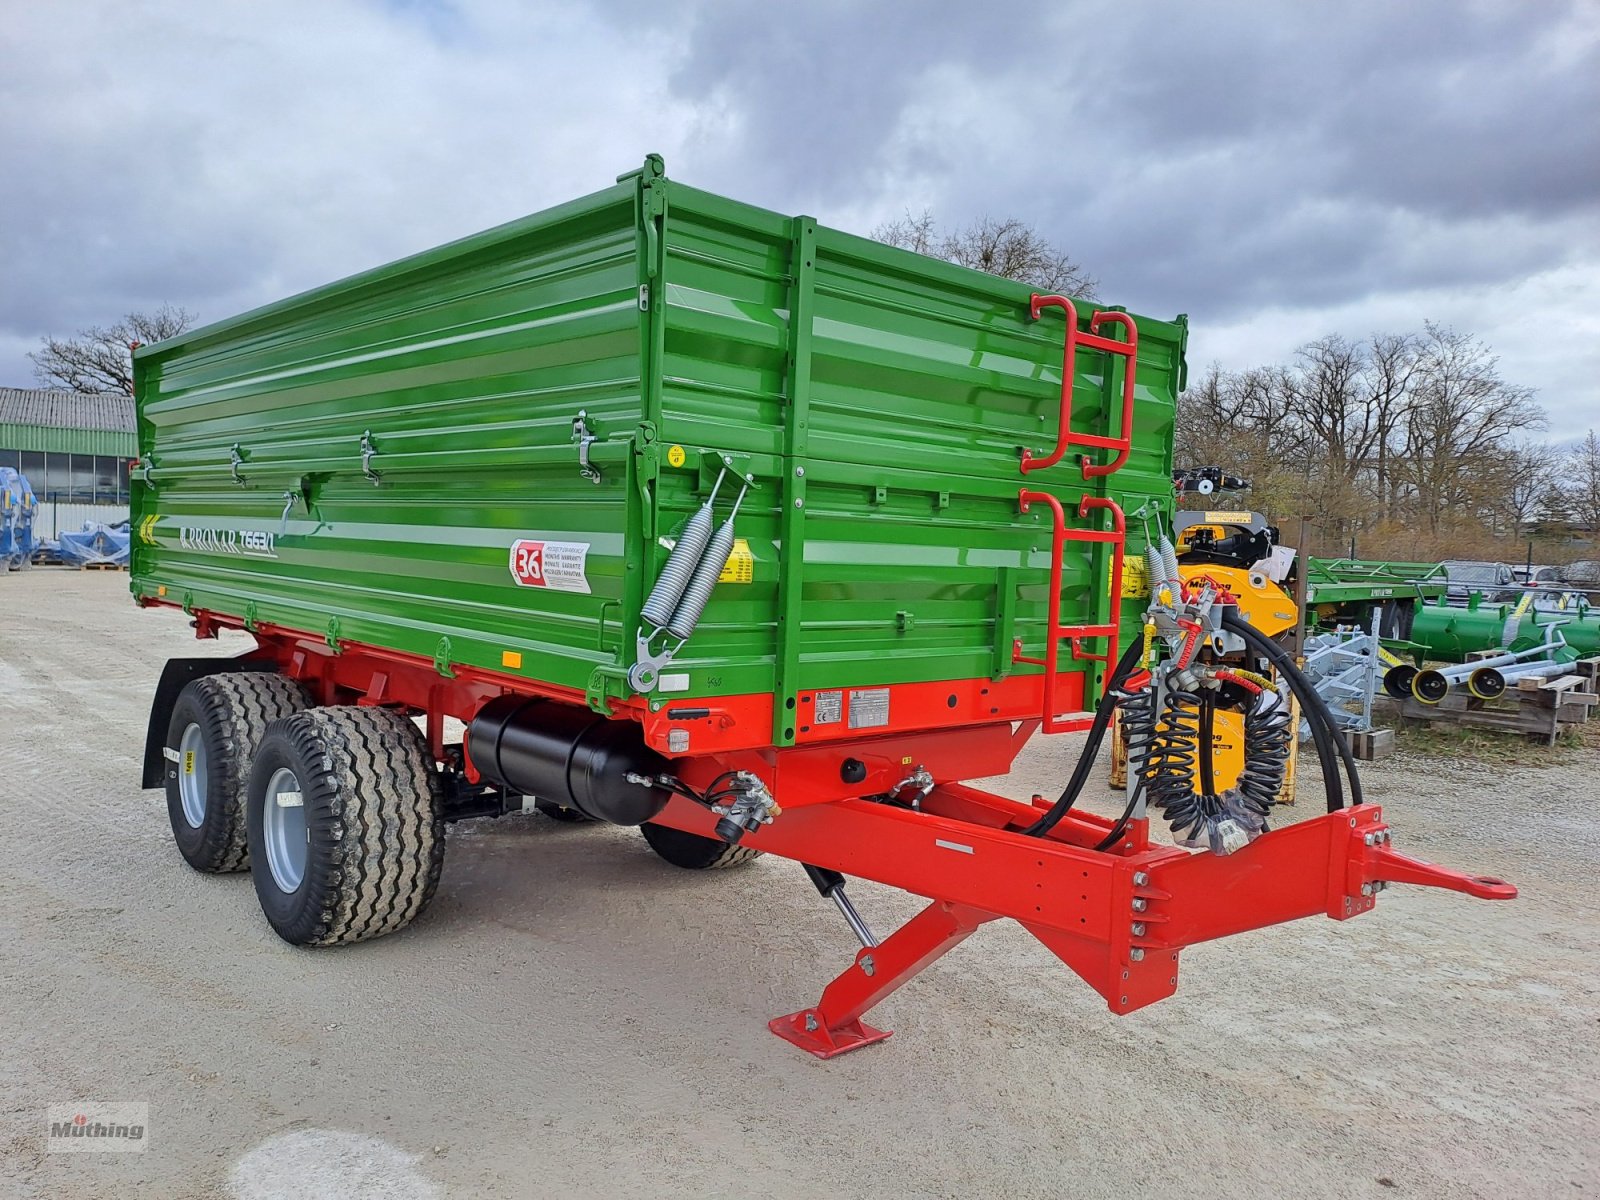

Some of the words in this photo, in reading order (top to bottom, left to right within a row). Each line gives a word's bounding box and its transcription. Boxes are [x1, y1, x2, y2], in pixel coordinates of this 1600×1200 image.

[189, 528, 241, 554] PRONAR
[240, 531, 275, 555] T663/1
[518, 549, 541, 579] 36
